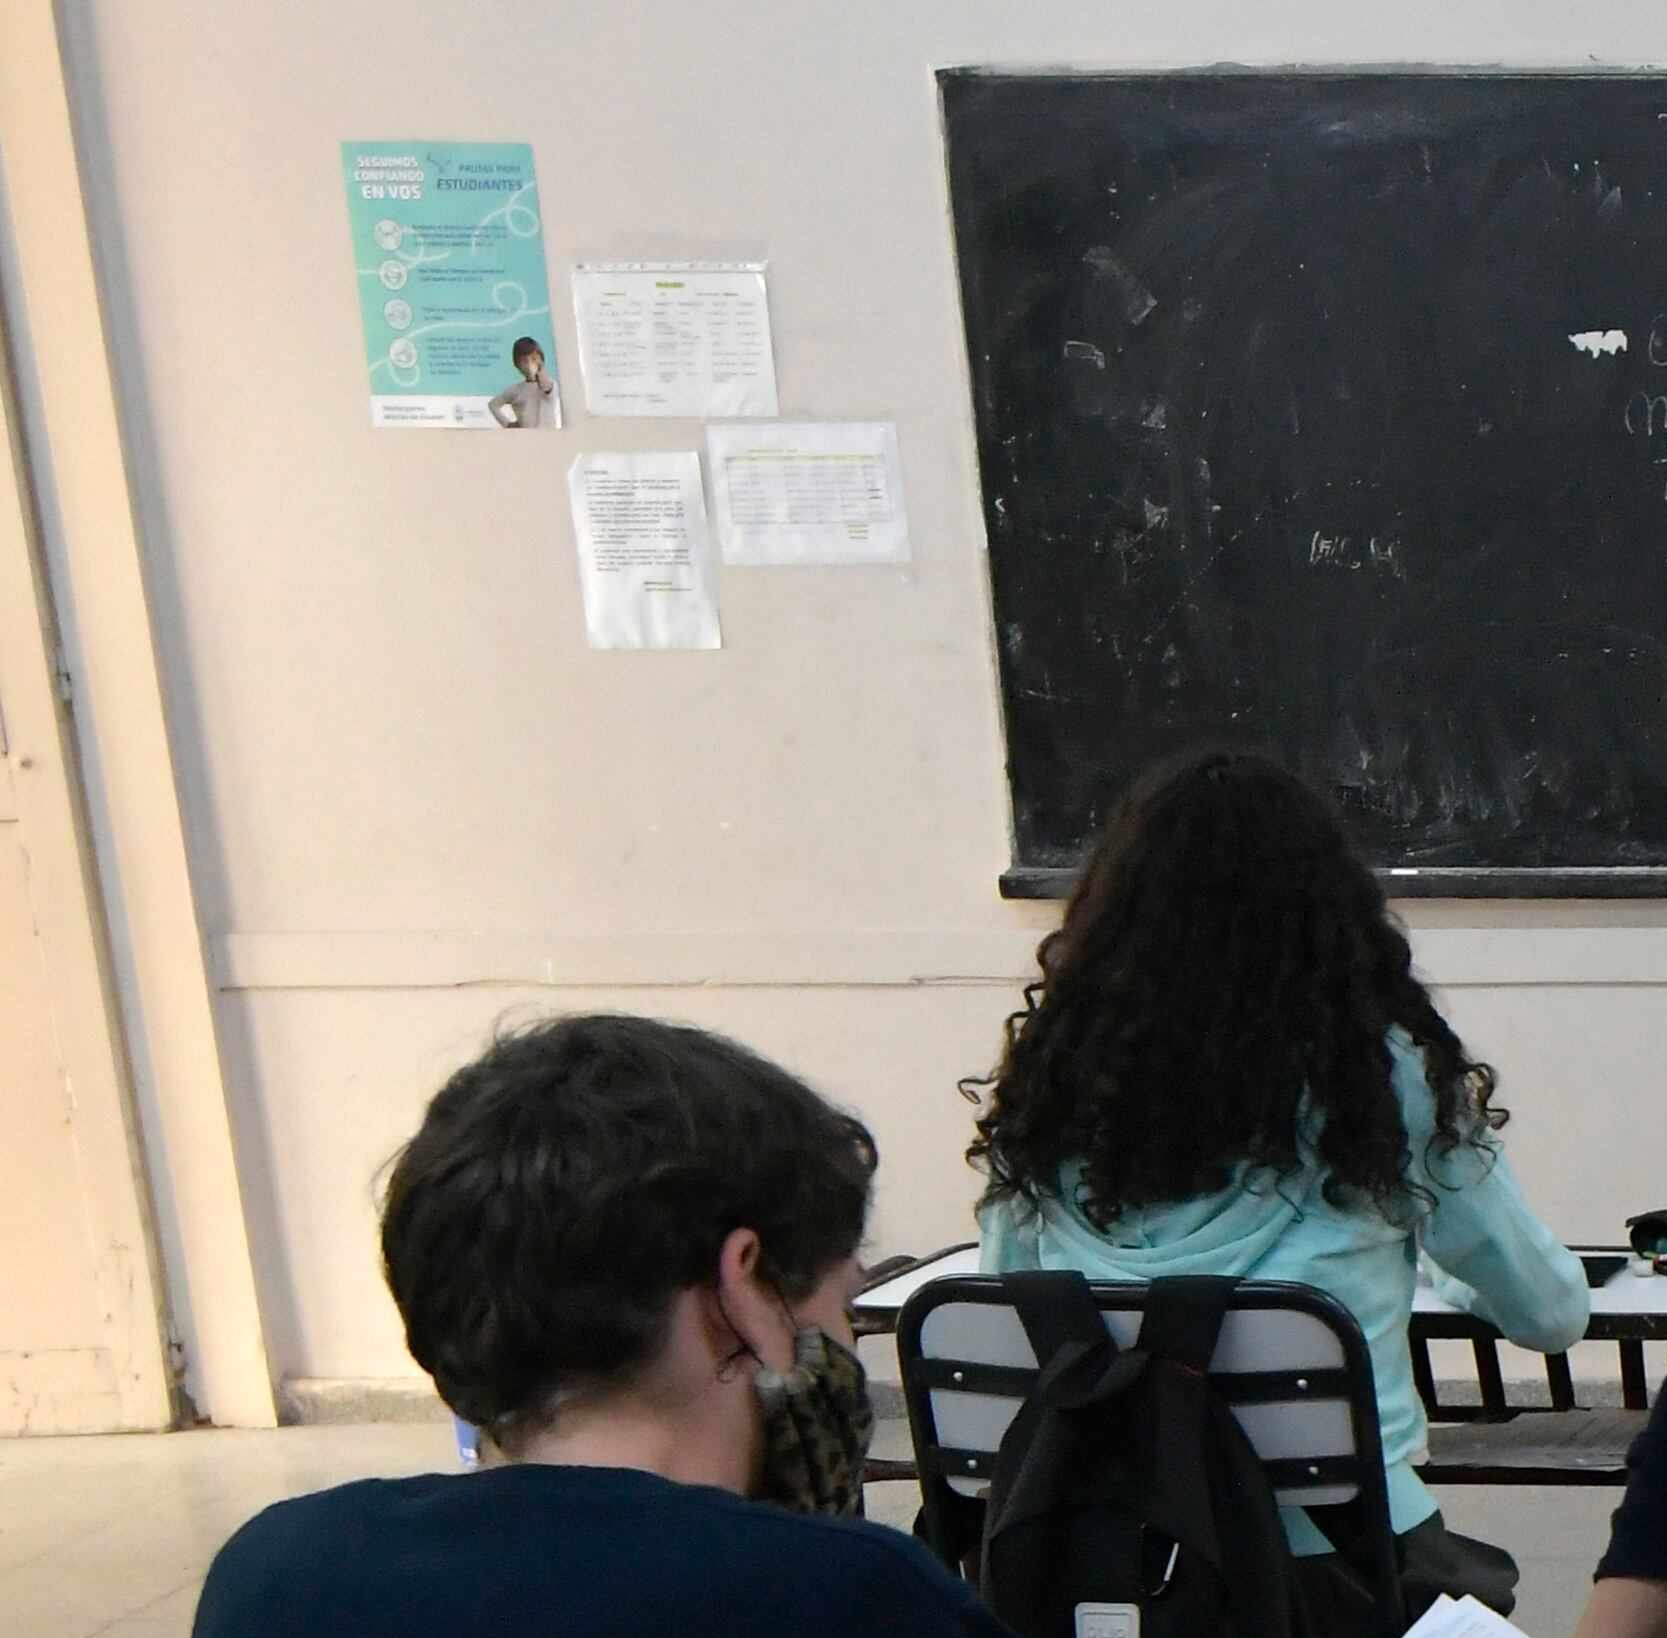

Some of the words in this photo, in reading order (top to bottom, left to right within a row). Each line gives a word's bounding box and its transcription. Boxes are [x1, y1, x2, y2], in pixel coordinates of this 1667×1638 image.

[358, 156, 418, 168] SEGUIMOS
[355, 171, 424, 182] CONFIANDO
[437, 178, 523, 191] ESTUDIANTES
[362, 185, 384, 199] EN
[389, 185, 421, 199] VOS
